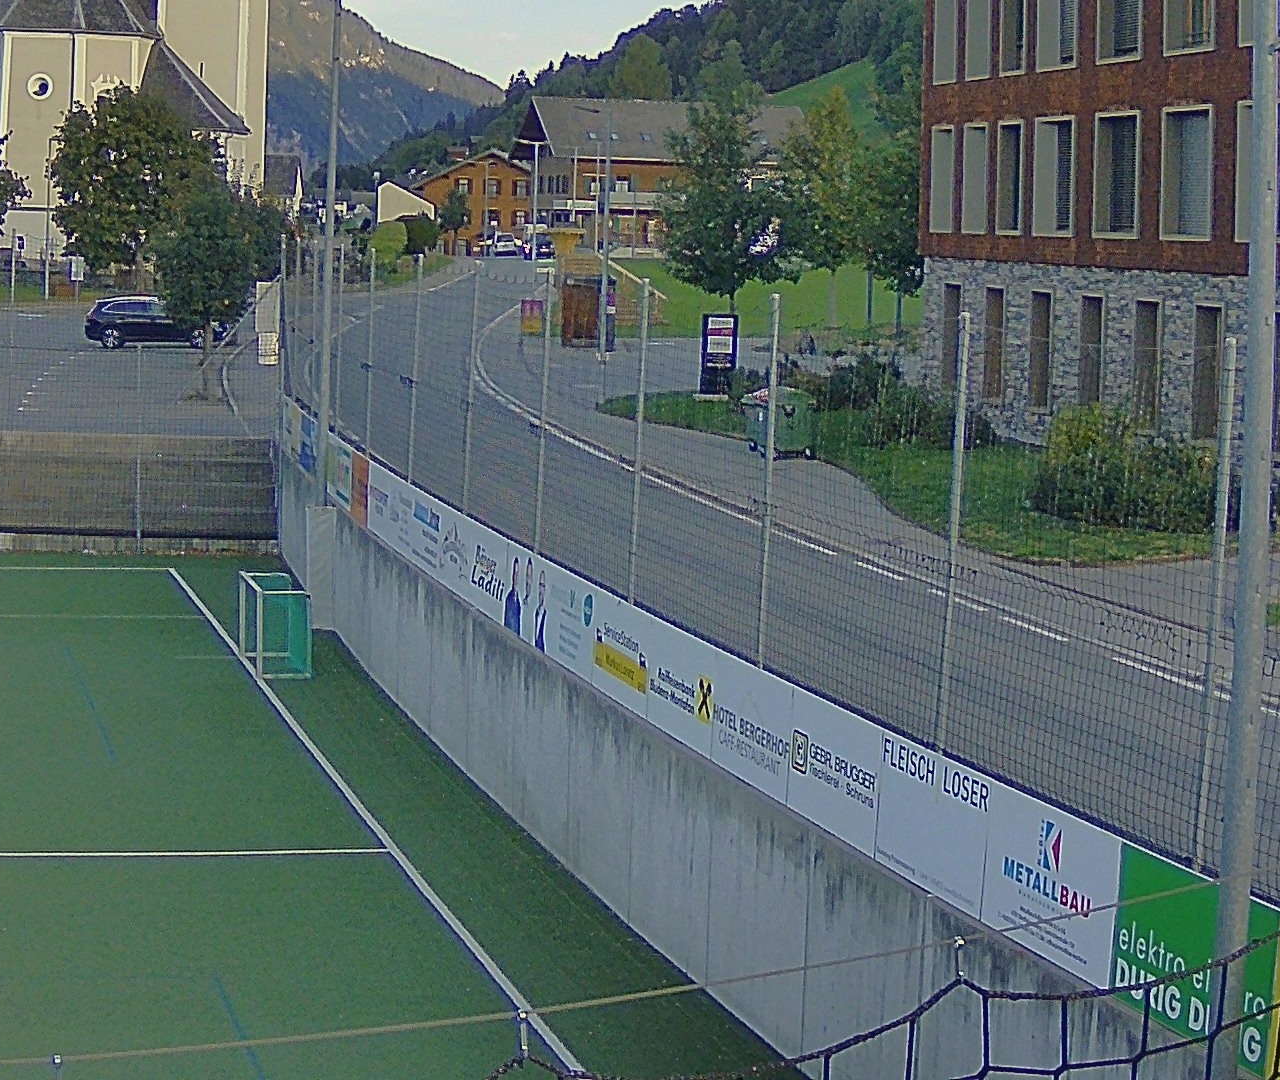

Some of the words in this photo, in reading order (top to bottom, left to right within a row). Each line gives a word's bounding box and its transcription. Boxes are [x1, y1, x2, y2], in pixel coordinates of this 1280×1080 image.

[713, 703, 737, 732] HOTEL
[739, 717, 790, 759] BERGERHOF
[834, 756, 876, 792] BRUGGER
[883, 737, 936, 786] FLEISCH
[943, 766, 989, 812] LOSER
[1003, 855, 1092, 918] METALLBAU
[1119, 921, 1185, 974] elektro
